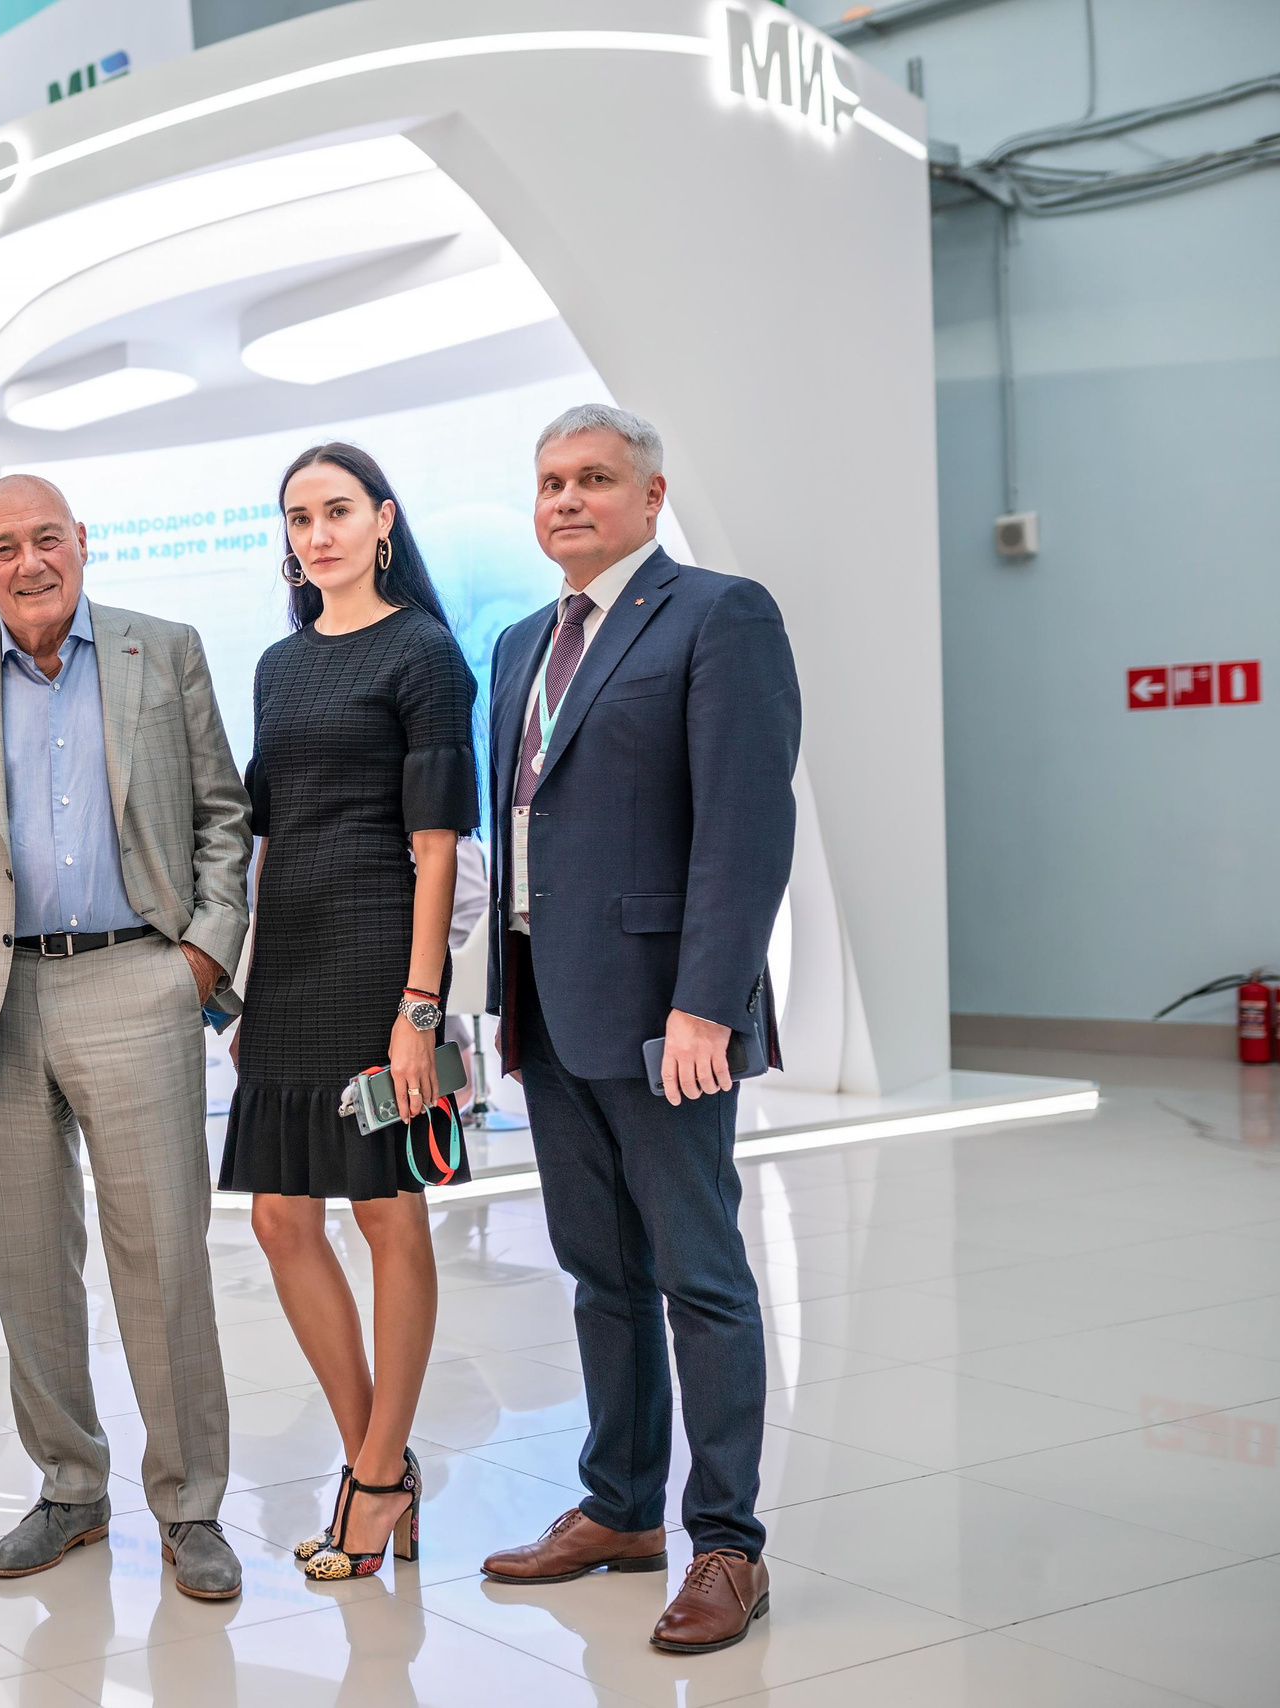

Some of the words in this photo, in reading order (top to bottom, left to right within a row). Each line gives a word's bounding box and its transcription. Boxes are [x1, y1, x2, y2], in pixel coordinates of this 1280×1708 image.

[726, 6, 859, 134] МИР
[86, 510, 217, 541] дународное
[116, 545, 141, 562] на
[148, 538, 208, 560] карте
[215, 531, 269, 552] мира
